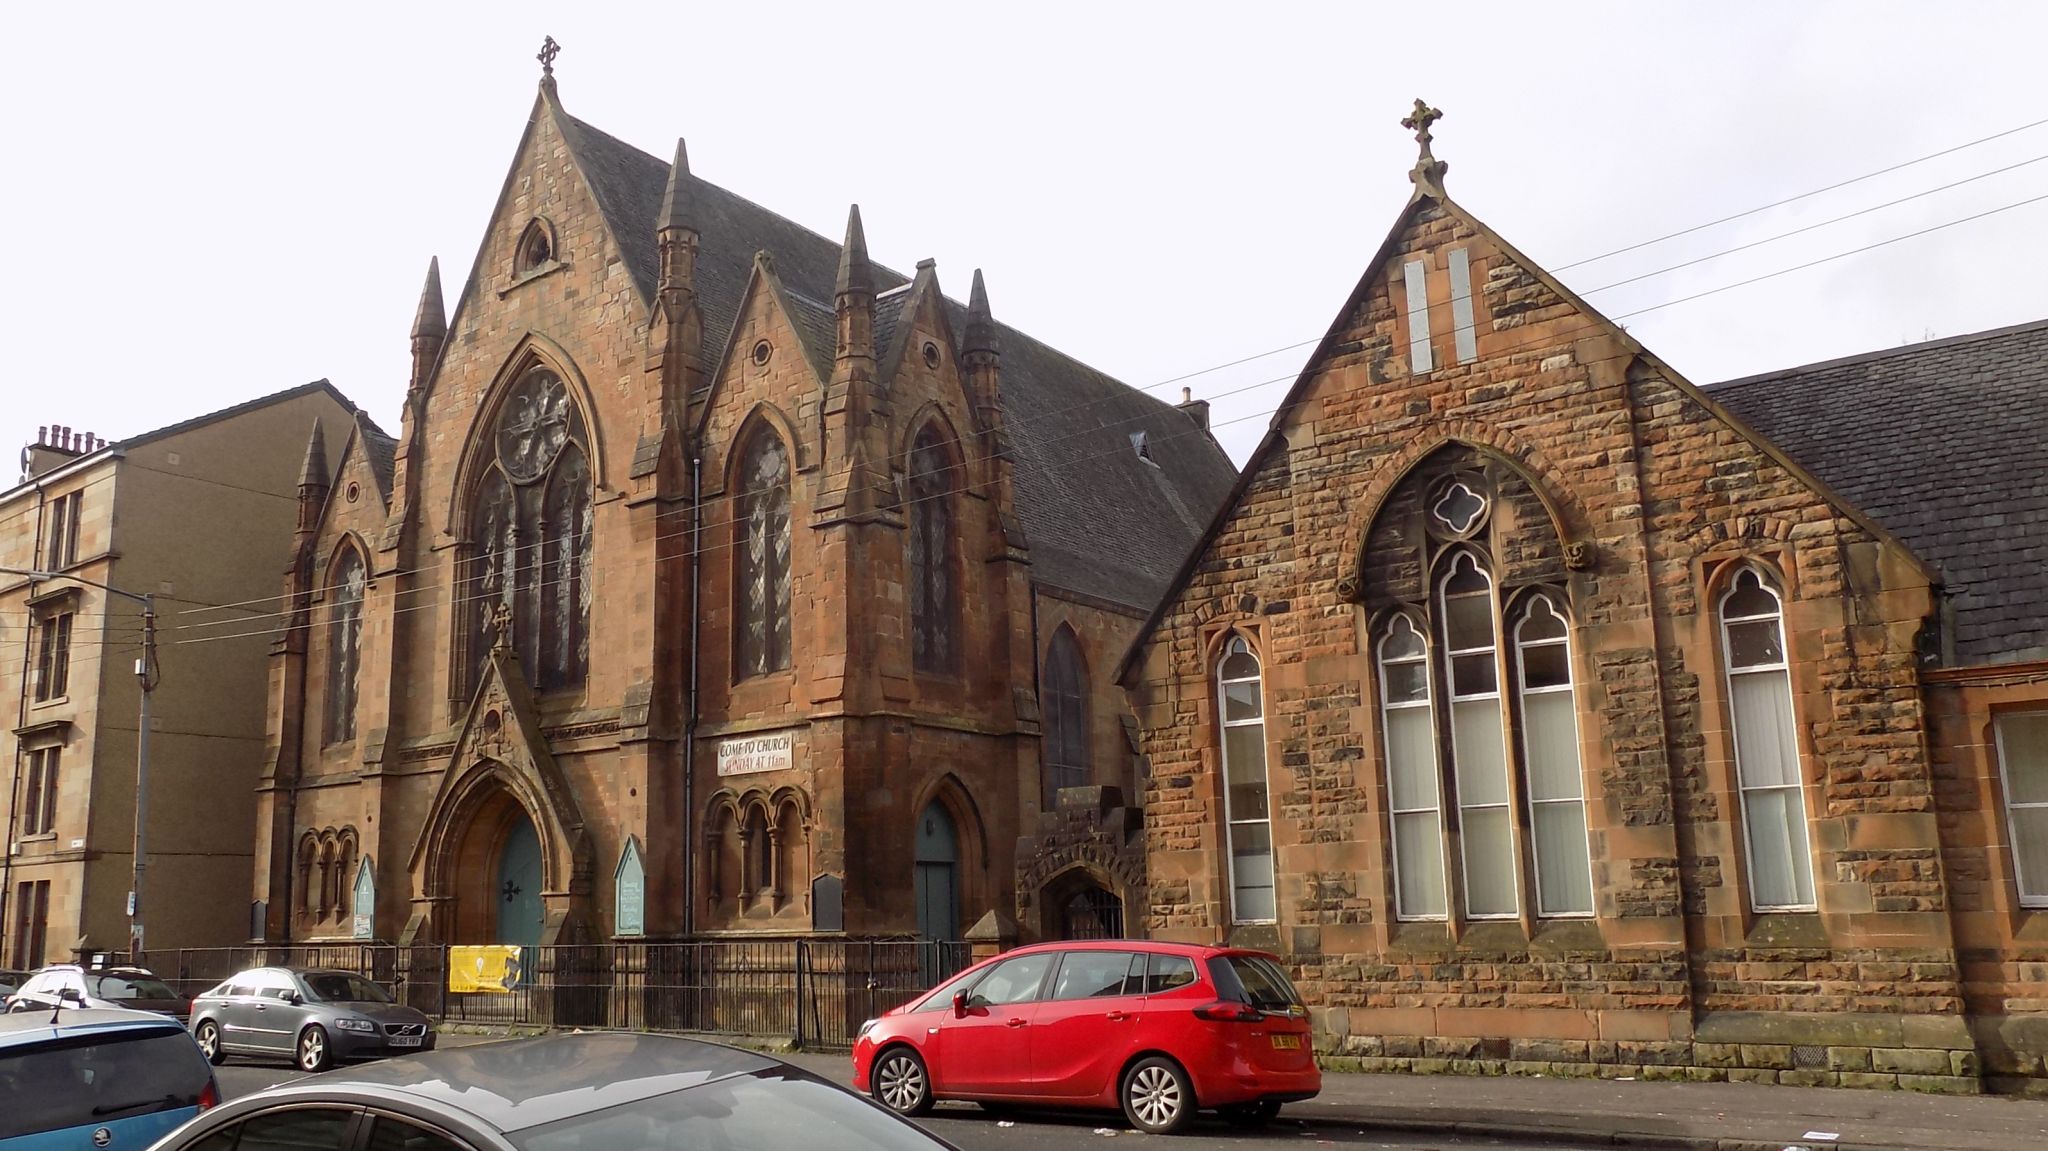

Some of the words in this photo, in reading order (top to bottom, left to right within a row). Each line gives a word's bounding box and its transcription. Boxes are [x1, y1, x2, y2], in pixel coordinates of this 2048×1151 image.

[720, 742, 743, 757] COME
[744, 741, 755, 754] TO
[757, 737, 790, 753] CHURCH
[724, 757, 754, 773] SUNDAY
[756, 756, 765, 769] AT
[767, 755, 785, 768] 11am
